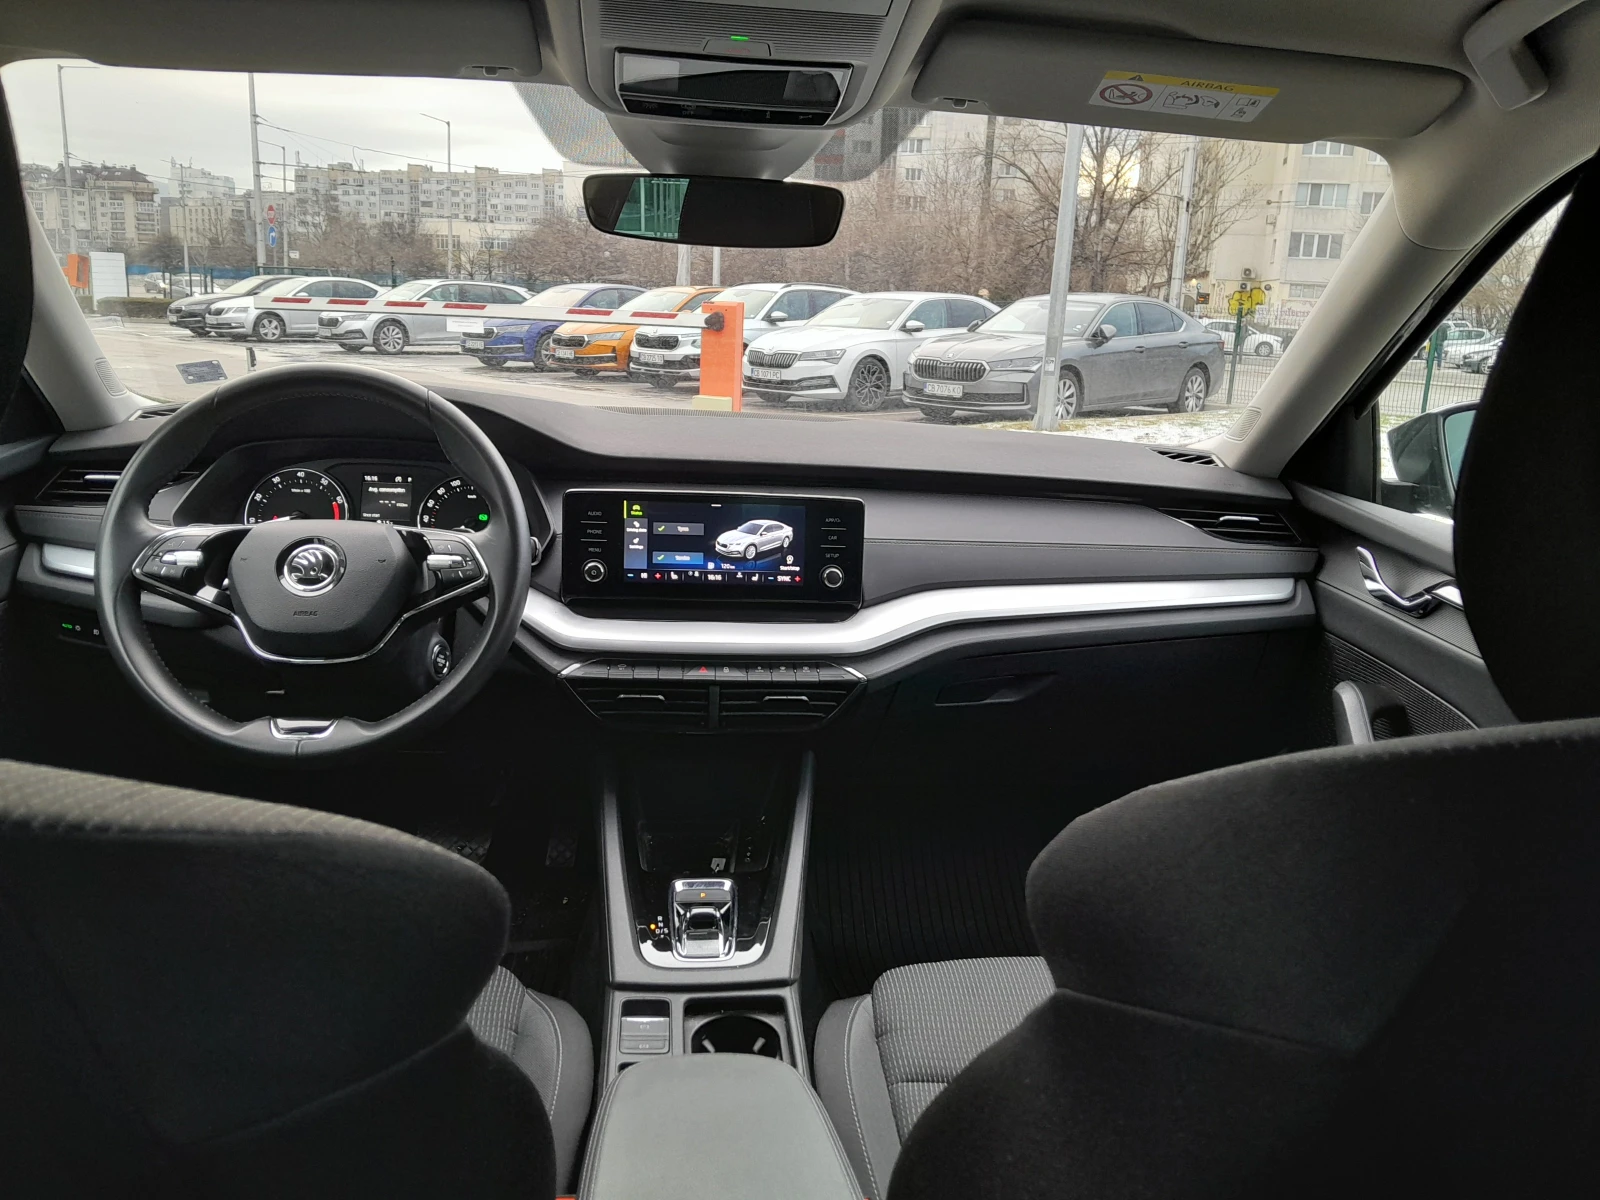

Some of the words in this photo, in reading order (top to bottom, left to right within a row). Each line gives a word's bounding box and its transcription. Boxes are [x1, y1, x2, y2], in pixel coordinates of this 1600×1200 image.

[1180, 80, 1235, 92] AIRBAG
[761, 369, 772, 378] 1071
[936, 384, 951, 394] 7076
[272, 476, 281, 484] 30
[320, 478, 329, 486] 50
[450, 479, 461, 487] 100
[437, 487, 446, 495] 80
[254, 493, 263, 502] 20
